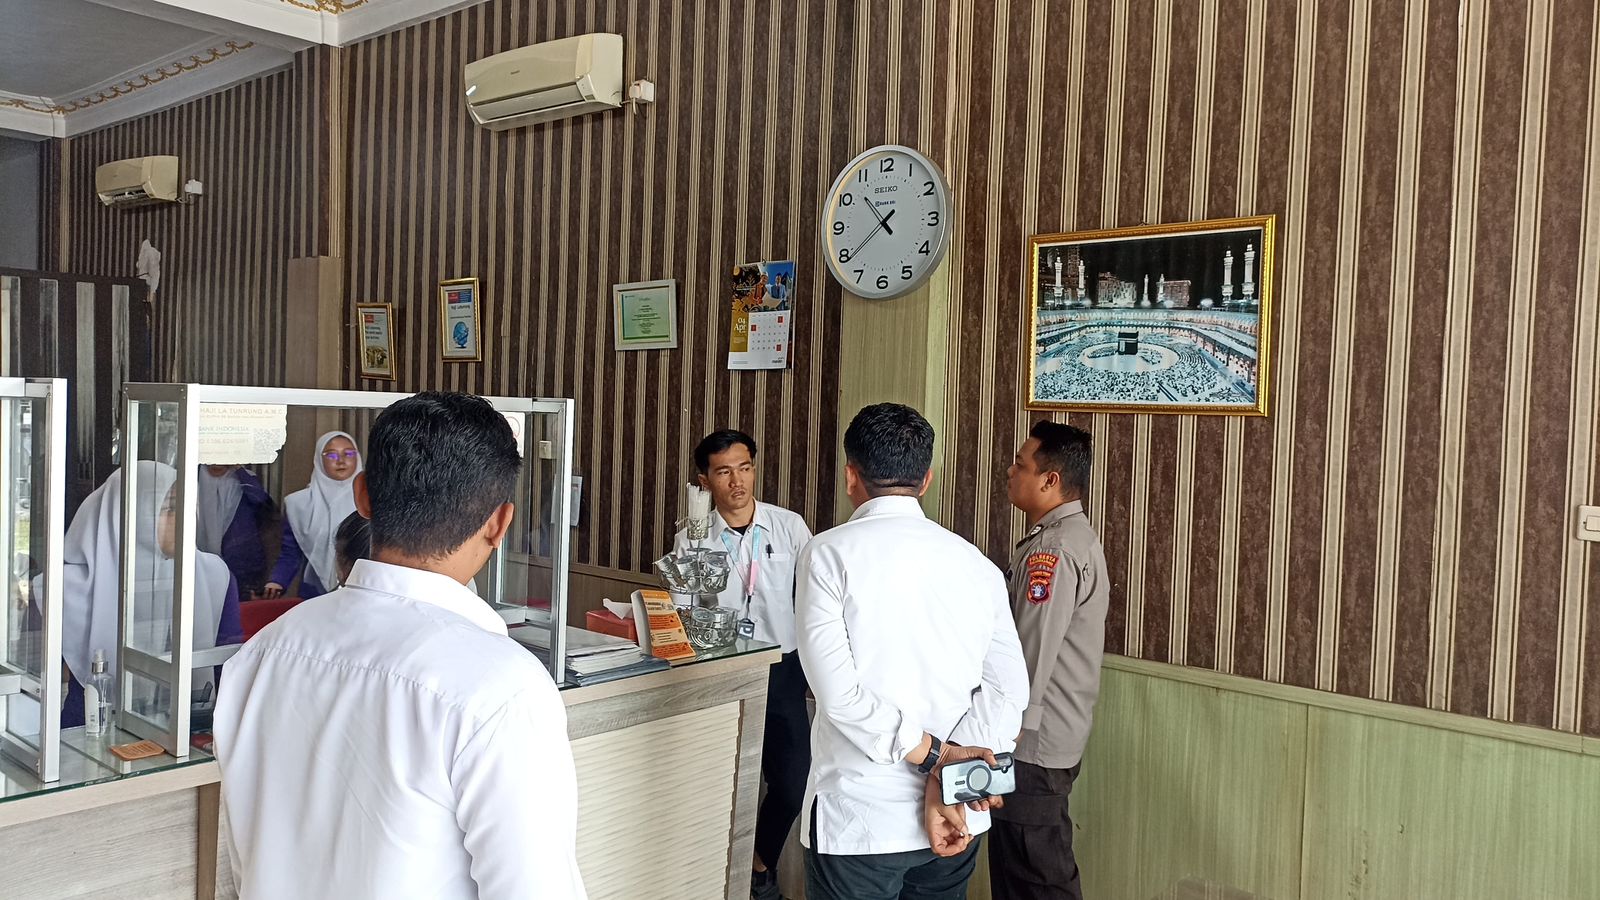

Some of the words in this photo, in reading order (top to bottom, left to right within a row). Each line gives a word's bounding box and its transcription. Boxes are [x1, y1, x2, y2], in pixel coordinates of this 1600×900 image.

[880, 157, 894, 173] 12
[908, 163, 913, 177] 1
[858, 168, 868, 182] 11
[874, 185, 898, 194] SEIKO
[923, 181, 935, 196] 2
[839, 192, 853, 207] 10
[927, 211, 940, 227] 3
[833, 221, 845, 236] 9
[838, 248, 850, 263] 8
[918, 240, 930, 256] 4
[853, 269, 864, 284] 7
[901, 265, 913, 280] 5
[876, 275, 889, 289] 6
